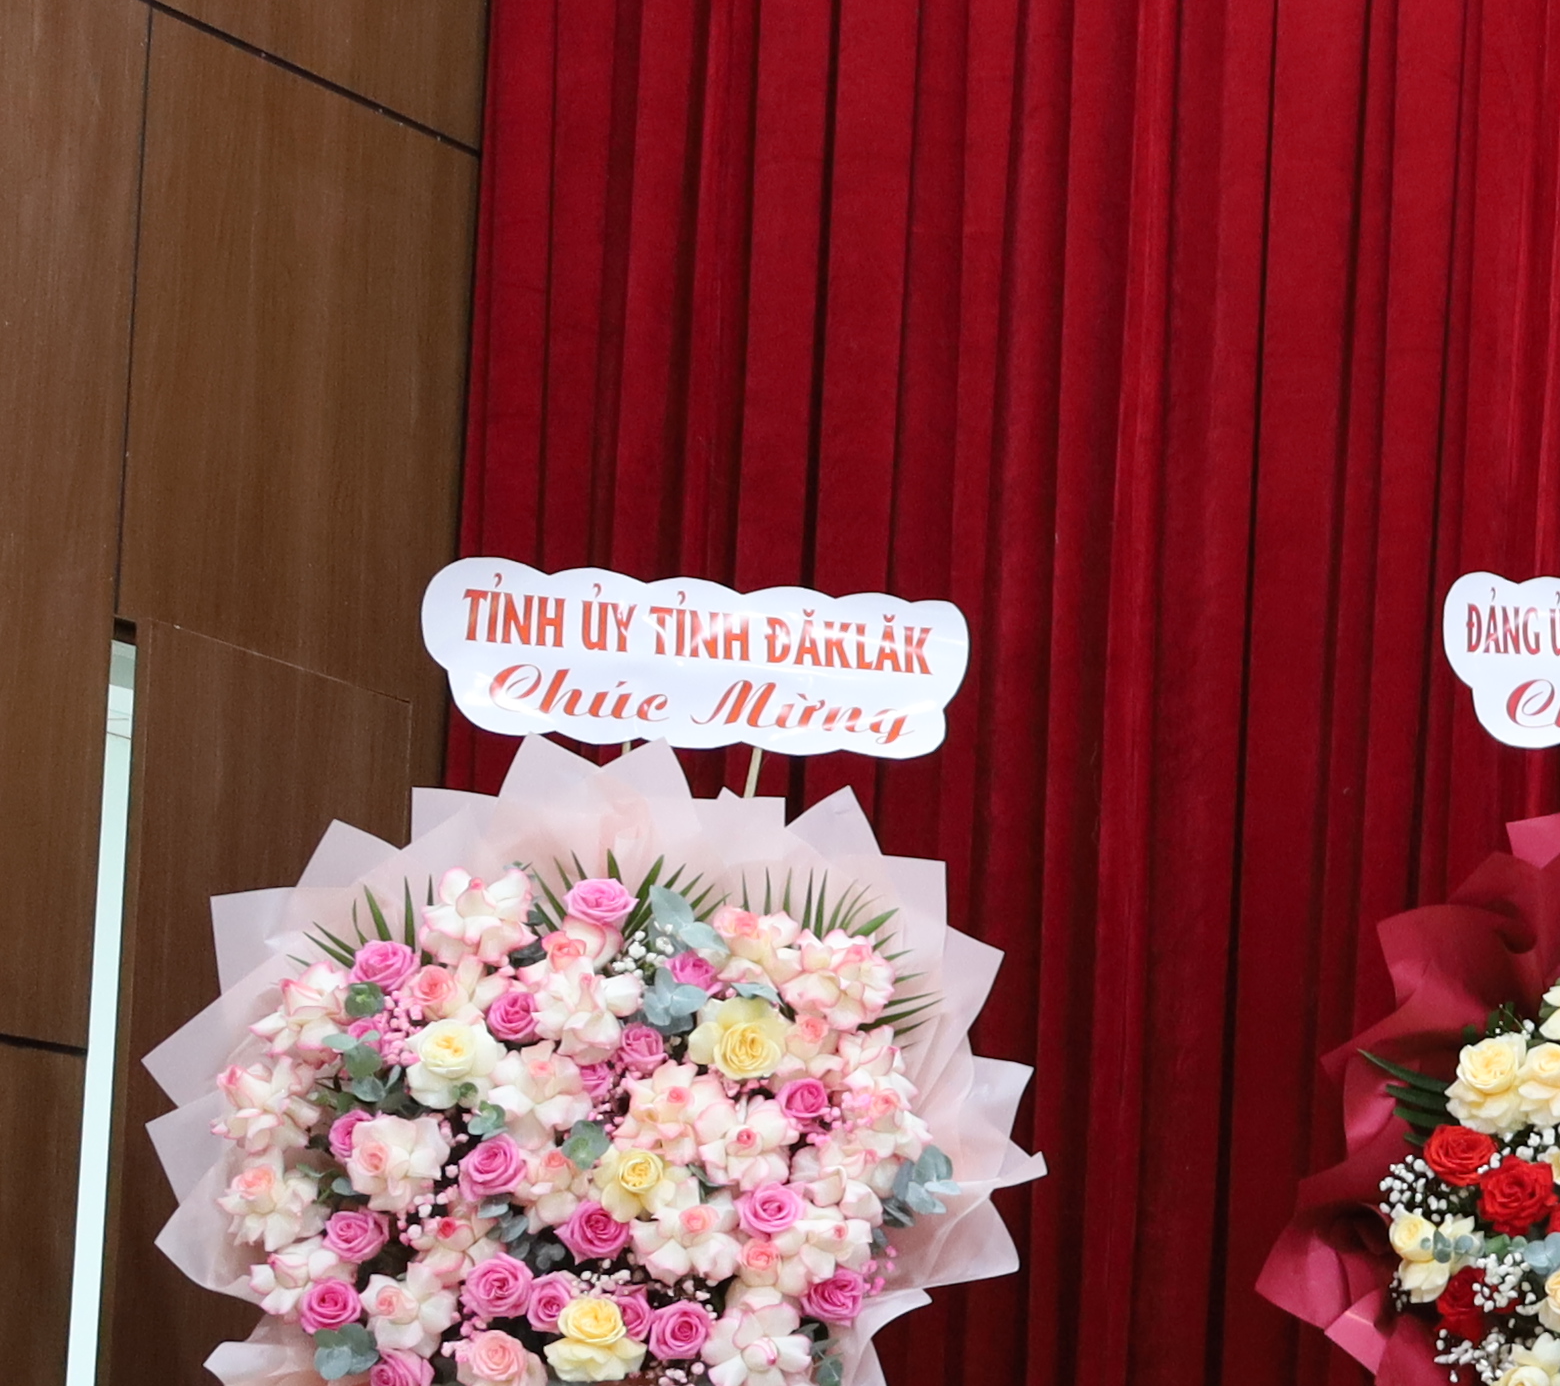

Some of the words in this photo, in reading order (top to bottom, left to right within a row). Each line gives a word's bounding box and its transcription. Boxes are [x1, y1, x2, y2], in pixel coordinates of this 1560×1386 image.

[461, 573, 567, 648] TỈNH
[580, 583, 637, 653] ỦY
[648, 589, 751, 663] TỈNH
[764, 609, 934, 675] ĐĂKLĂK
[1465, 587, 1541, 656] ĐẢNG
[488, 663, 670, 724] Chúc
[690, 679, 915, 744] Mừng
